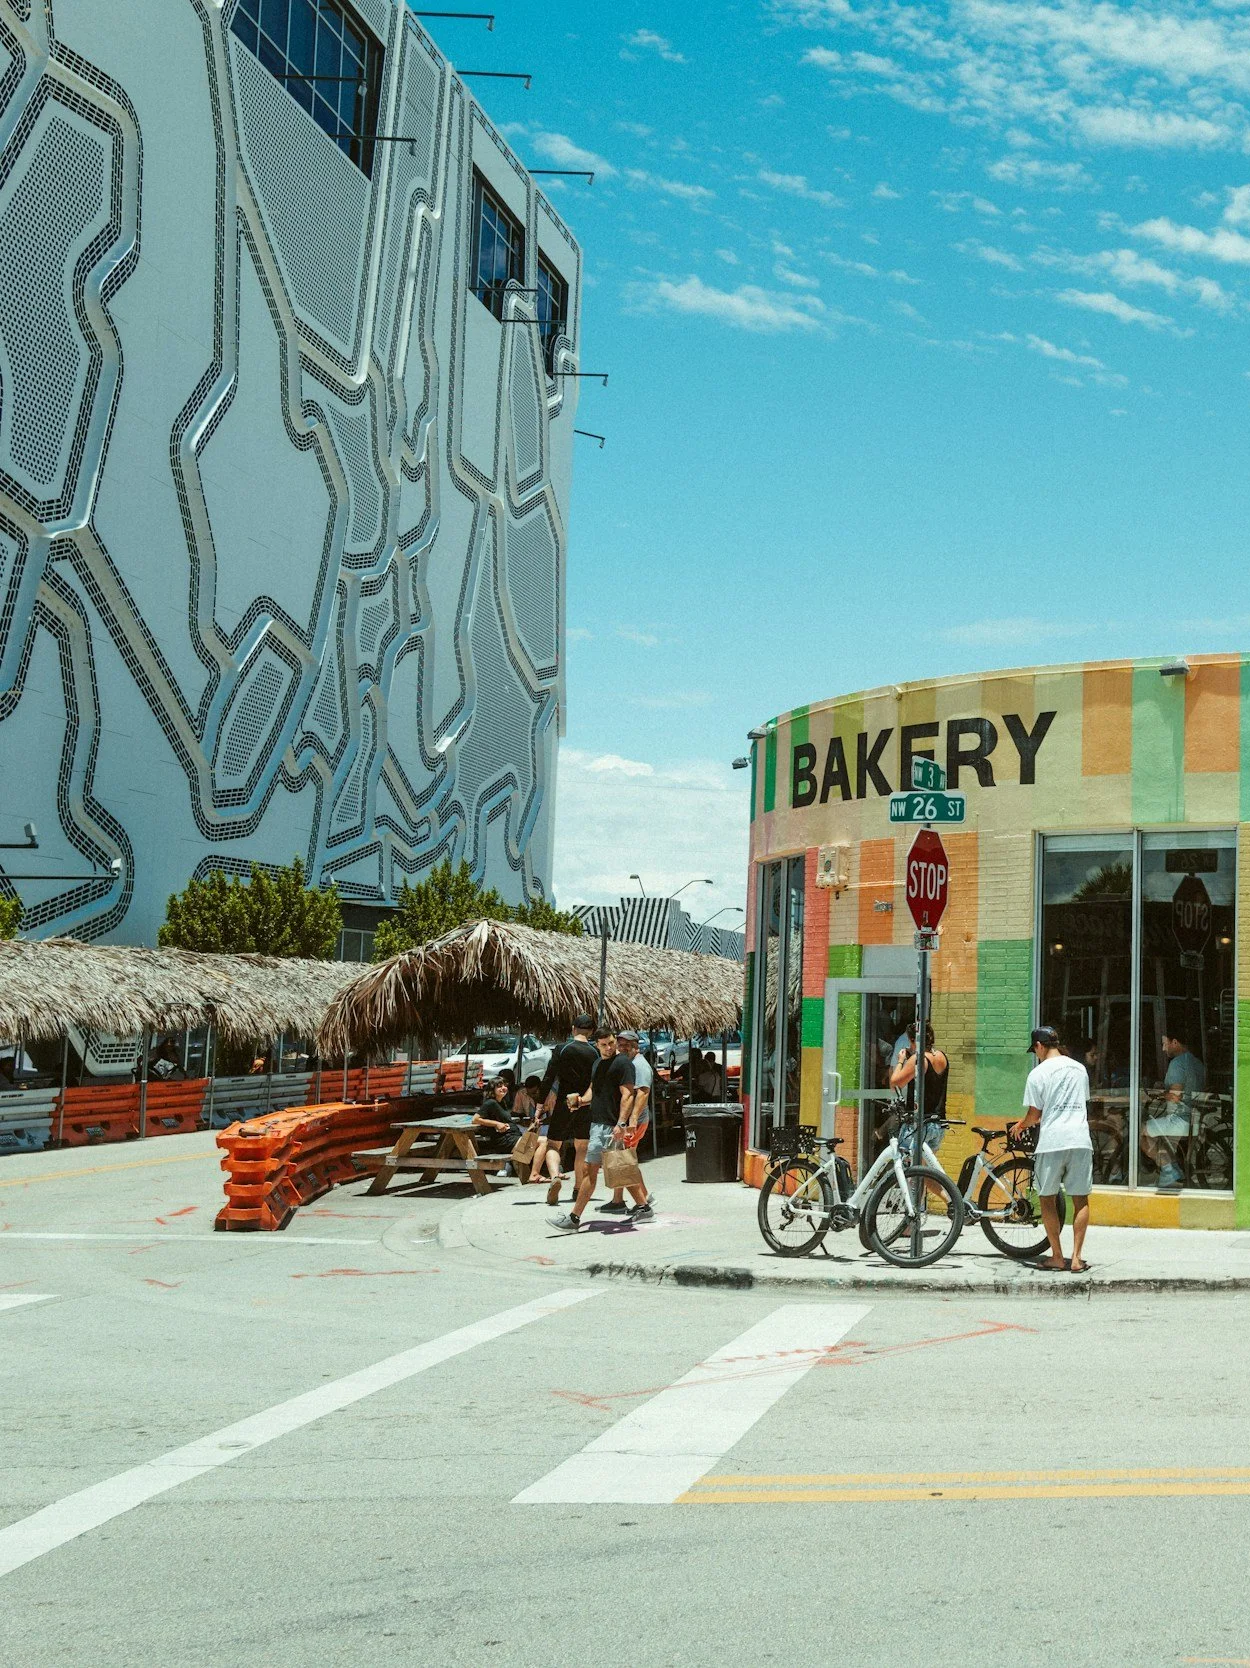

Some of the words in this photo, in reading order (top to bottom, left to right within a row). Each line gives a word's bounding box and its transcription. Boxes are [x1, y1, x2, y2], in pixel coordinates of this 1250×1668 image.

[793, 711, 1057, 808] BAKERY
[891, 801, 906, 817] NW
[912, 796, 938, 820] 26
[947, 800, 962, 817] ST
[908, 860, 947, 901] STOP
